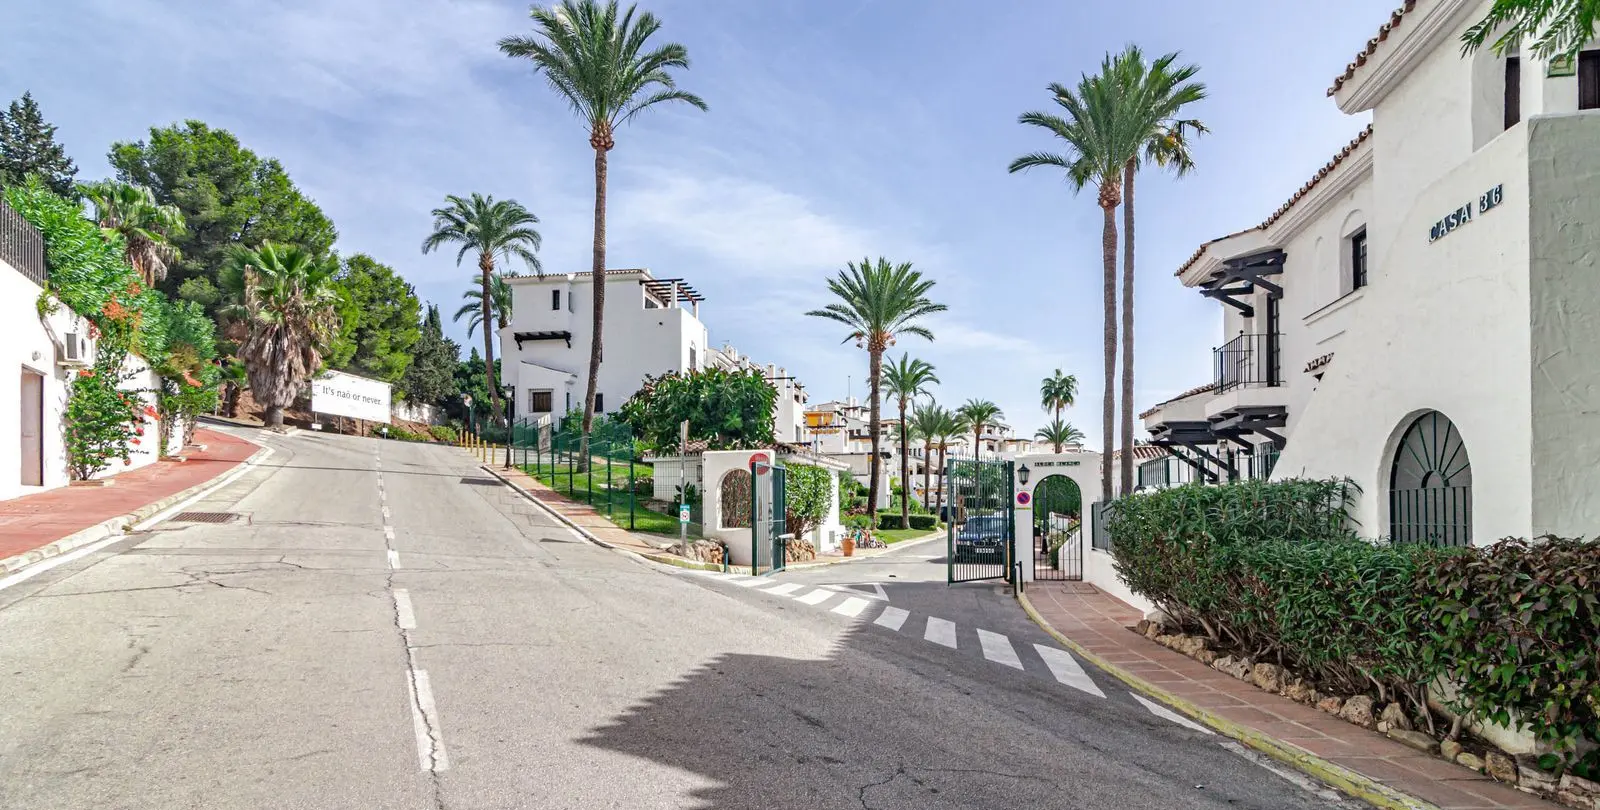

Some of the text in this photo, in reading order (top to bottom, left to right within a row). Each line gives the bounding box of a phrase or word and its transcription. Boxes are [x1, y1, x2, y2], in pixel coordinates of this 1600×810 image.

[1429, 184, 1501, 242] CASA 36
[322, 385, 335, 396] It's
[352, 393, 361, 401] or
